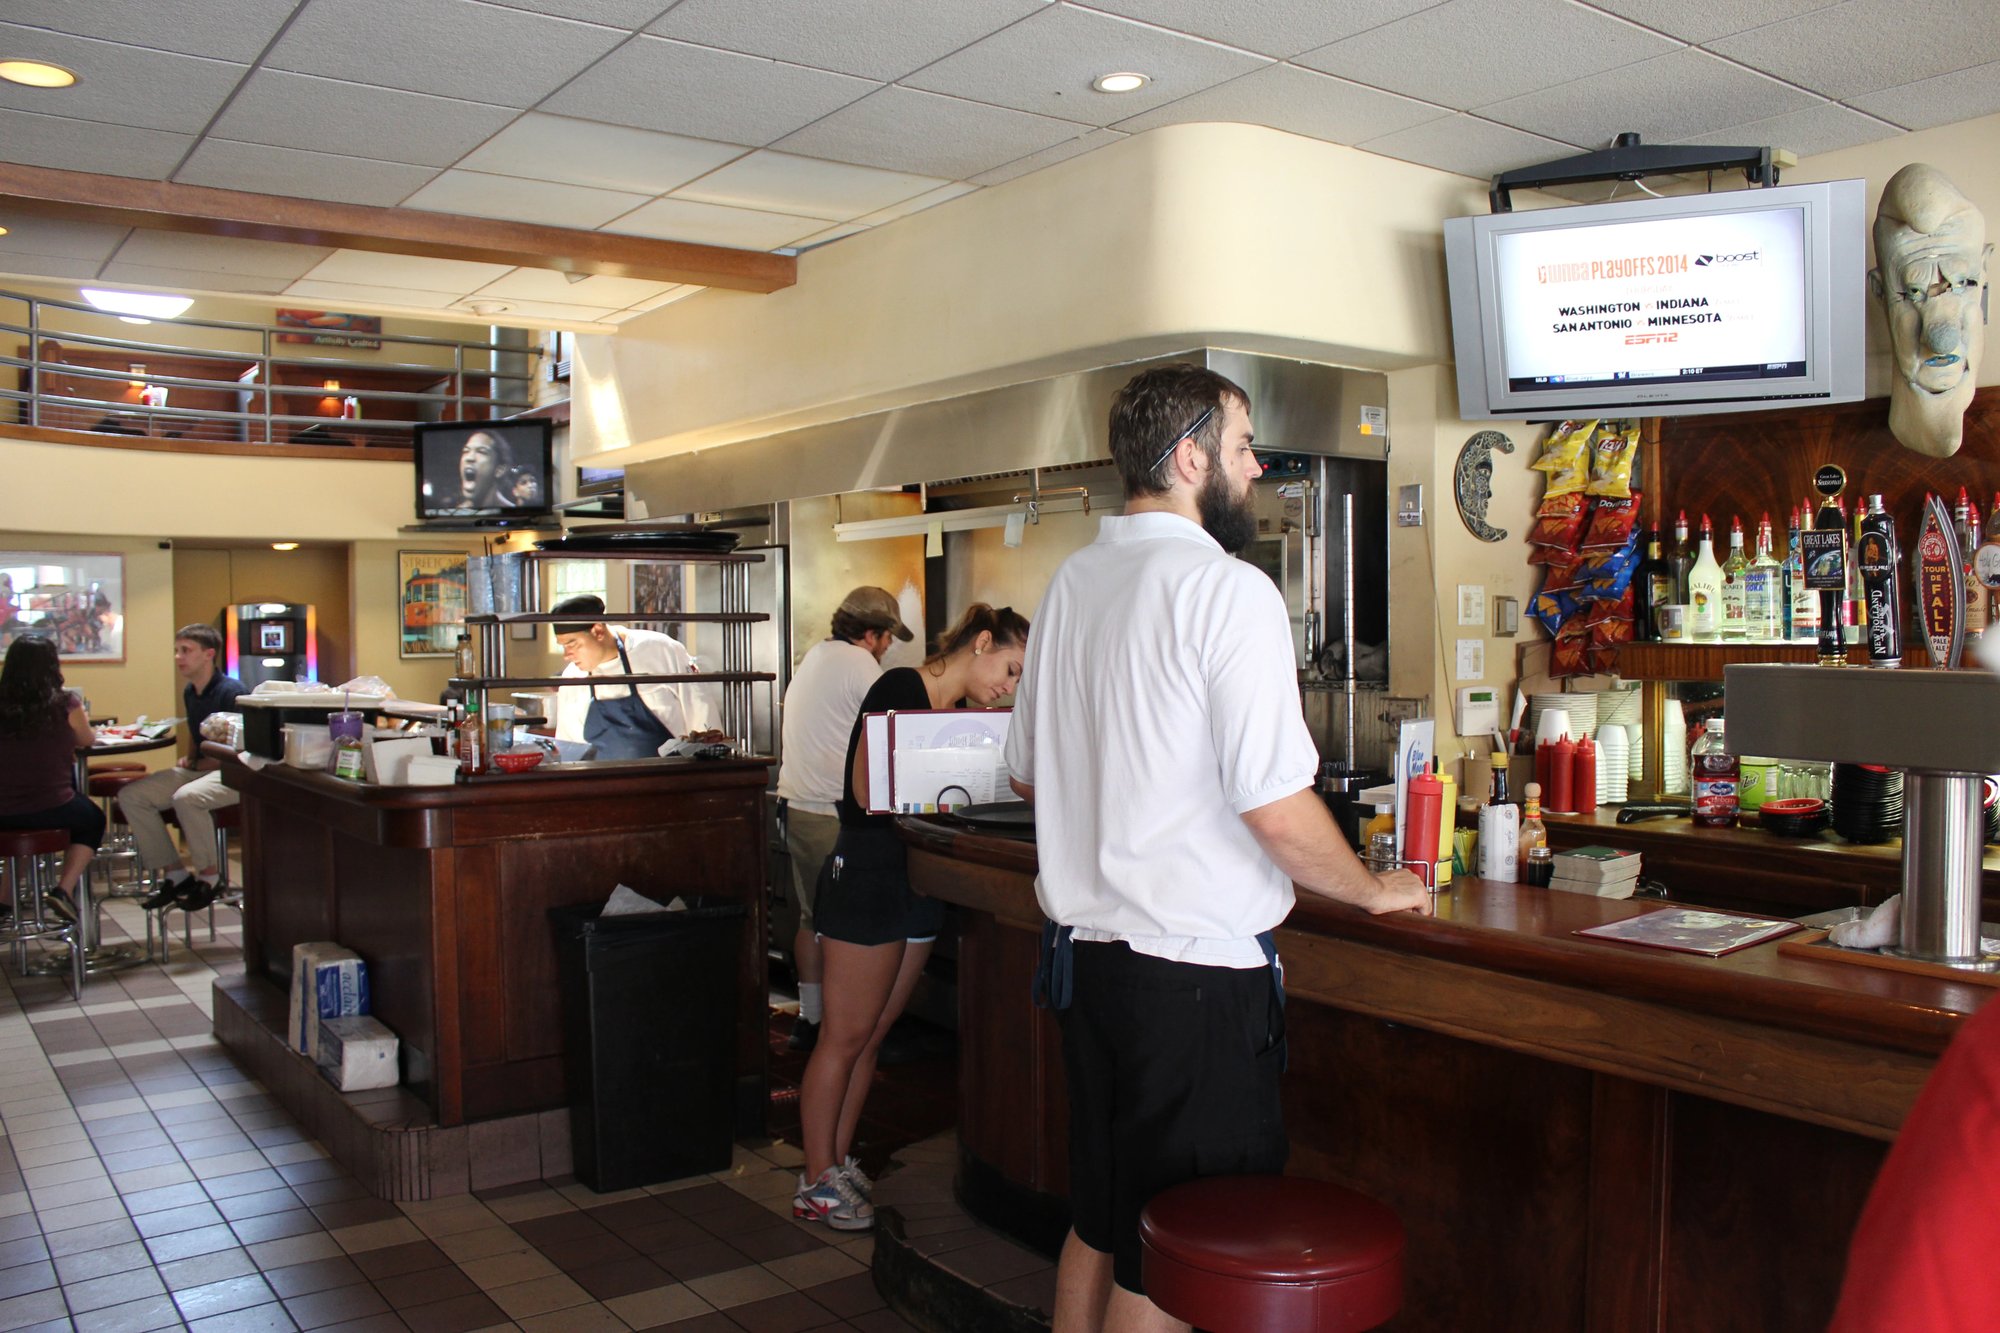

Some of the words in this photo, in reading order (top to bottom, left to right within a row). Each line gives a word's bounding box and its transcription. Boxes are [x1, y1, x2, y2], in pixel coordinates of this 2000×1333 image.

[1657, 254, 1688, 275] 2014
[1715, 249, 1760, 264] boost
[1558, 302, 1640, 317] WASHINGTON
[1656, 297, 1709, 310] INDIANA
[1552, 322, 1577, 334] SAN
[1579, 319, 1632, 332] ANTONIO
[1647, 312, 1722, 327] MINNESOTA
[1803, 534, 1821, 545] GREAT
[1821, 533, 1841, 544] LAKES
[1871, 590, 1883, 631] HOLLAND
[1932, 584, 1943, 632] FALL
[1873, 633, 1887, 654] NEW
[1412, 749, 1424, 761] Blue
